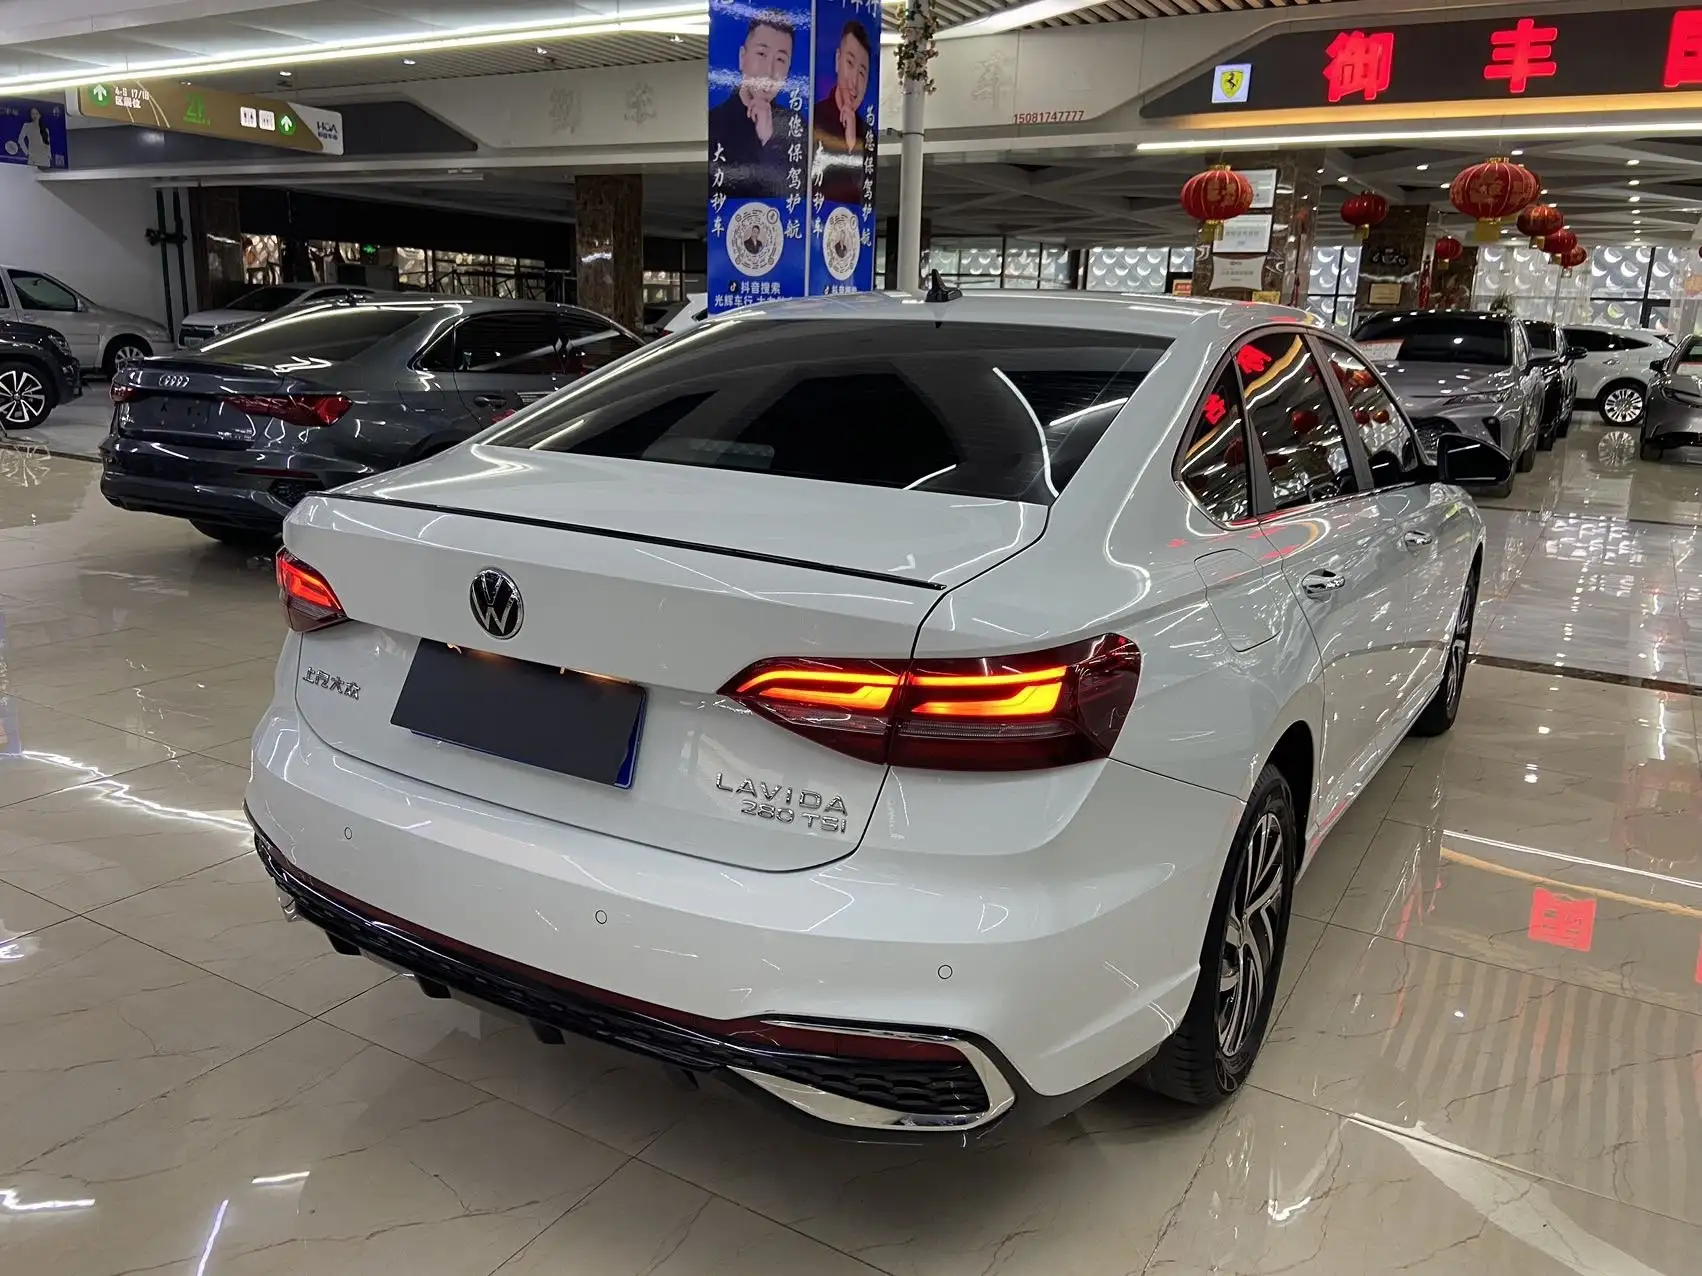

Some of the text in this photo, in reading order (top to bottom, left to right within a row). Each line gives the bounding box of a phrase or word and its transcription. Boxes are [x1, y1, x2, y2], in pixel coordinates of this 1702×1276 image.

[1013, 110, 1085, 124] 15081747777
[784, 87, 803, 240] 为您保驾护航
[740, 282, 781, 295] 抖音搜索
[715, 771, 848, 816] LAVIDA
[740, 799, 848, 834] 280 TSI
